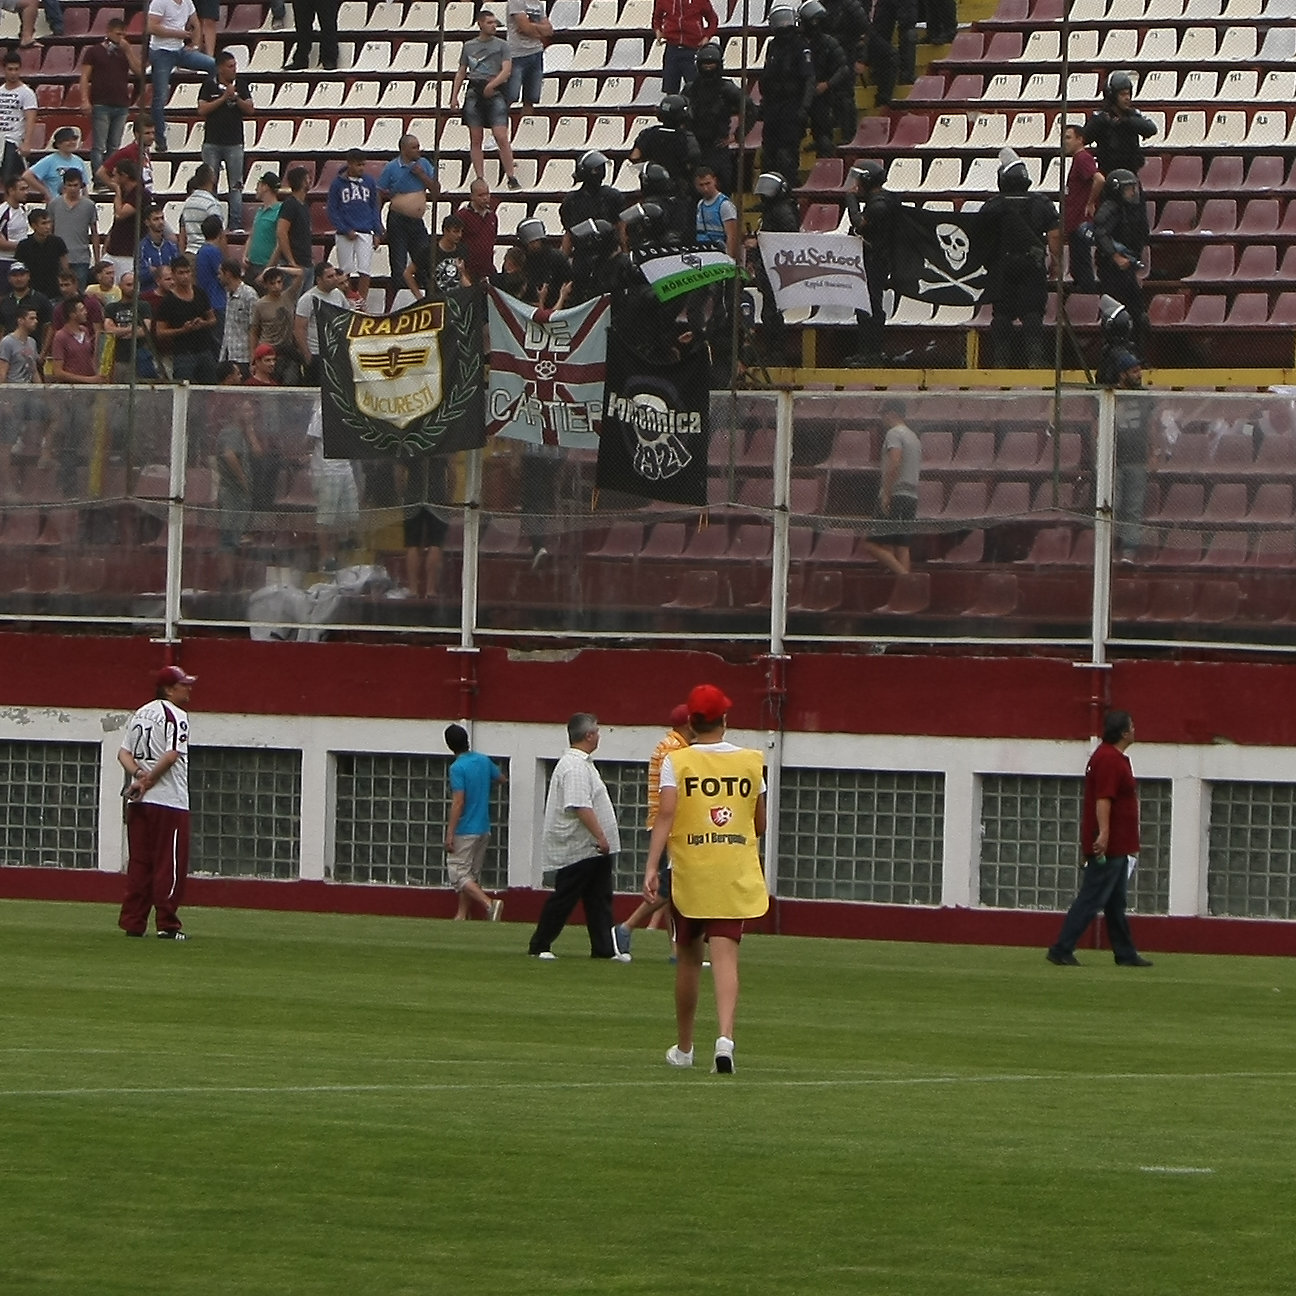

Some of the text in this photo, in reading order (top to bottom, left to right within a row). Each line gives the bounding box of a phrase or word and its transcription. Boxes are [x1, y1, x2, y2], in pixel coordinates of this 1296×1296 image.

[342, 184, 370, 203] GAP
[359, 309, 432, 335] RAPID
[524, 321, 572, 353] DE
[132, 724, 156, 760] 21
[685, 777, 751, 798] FOTO
